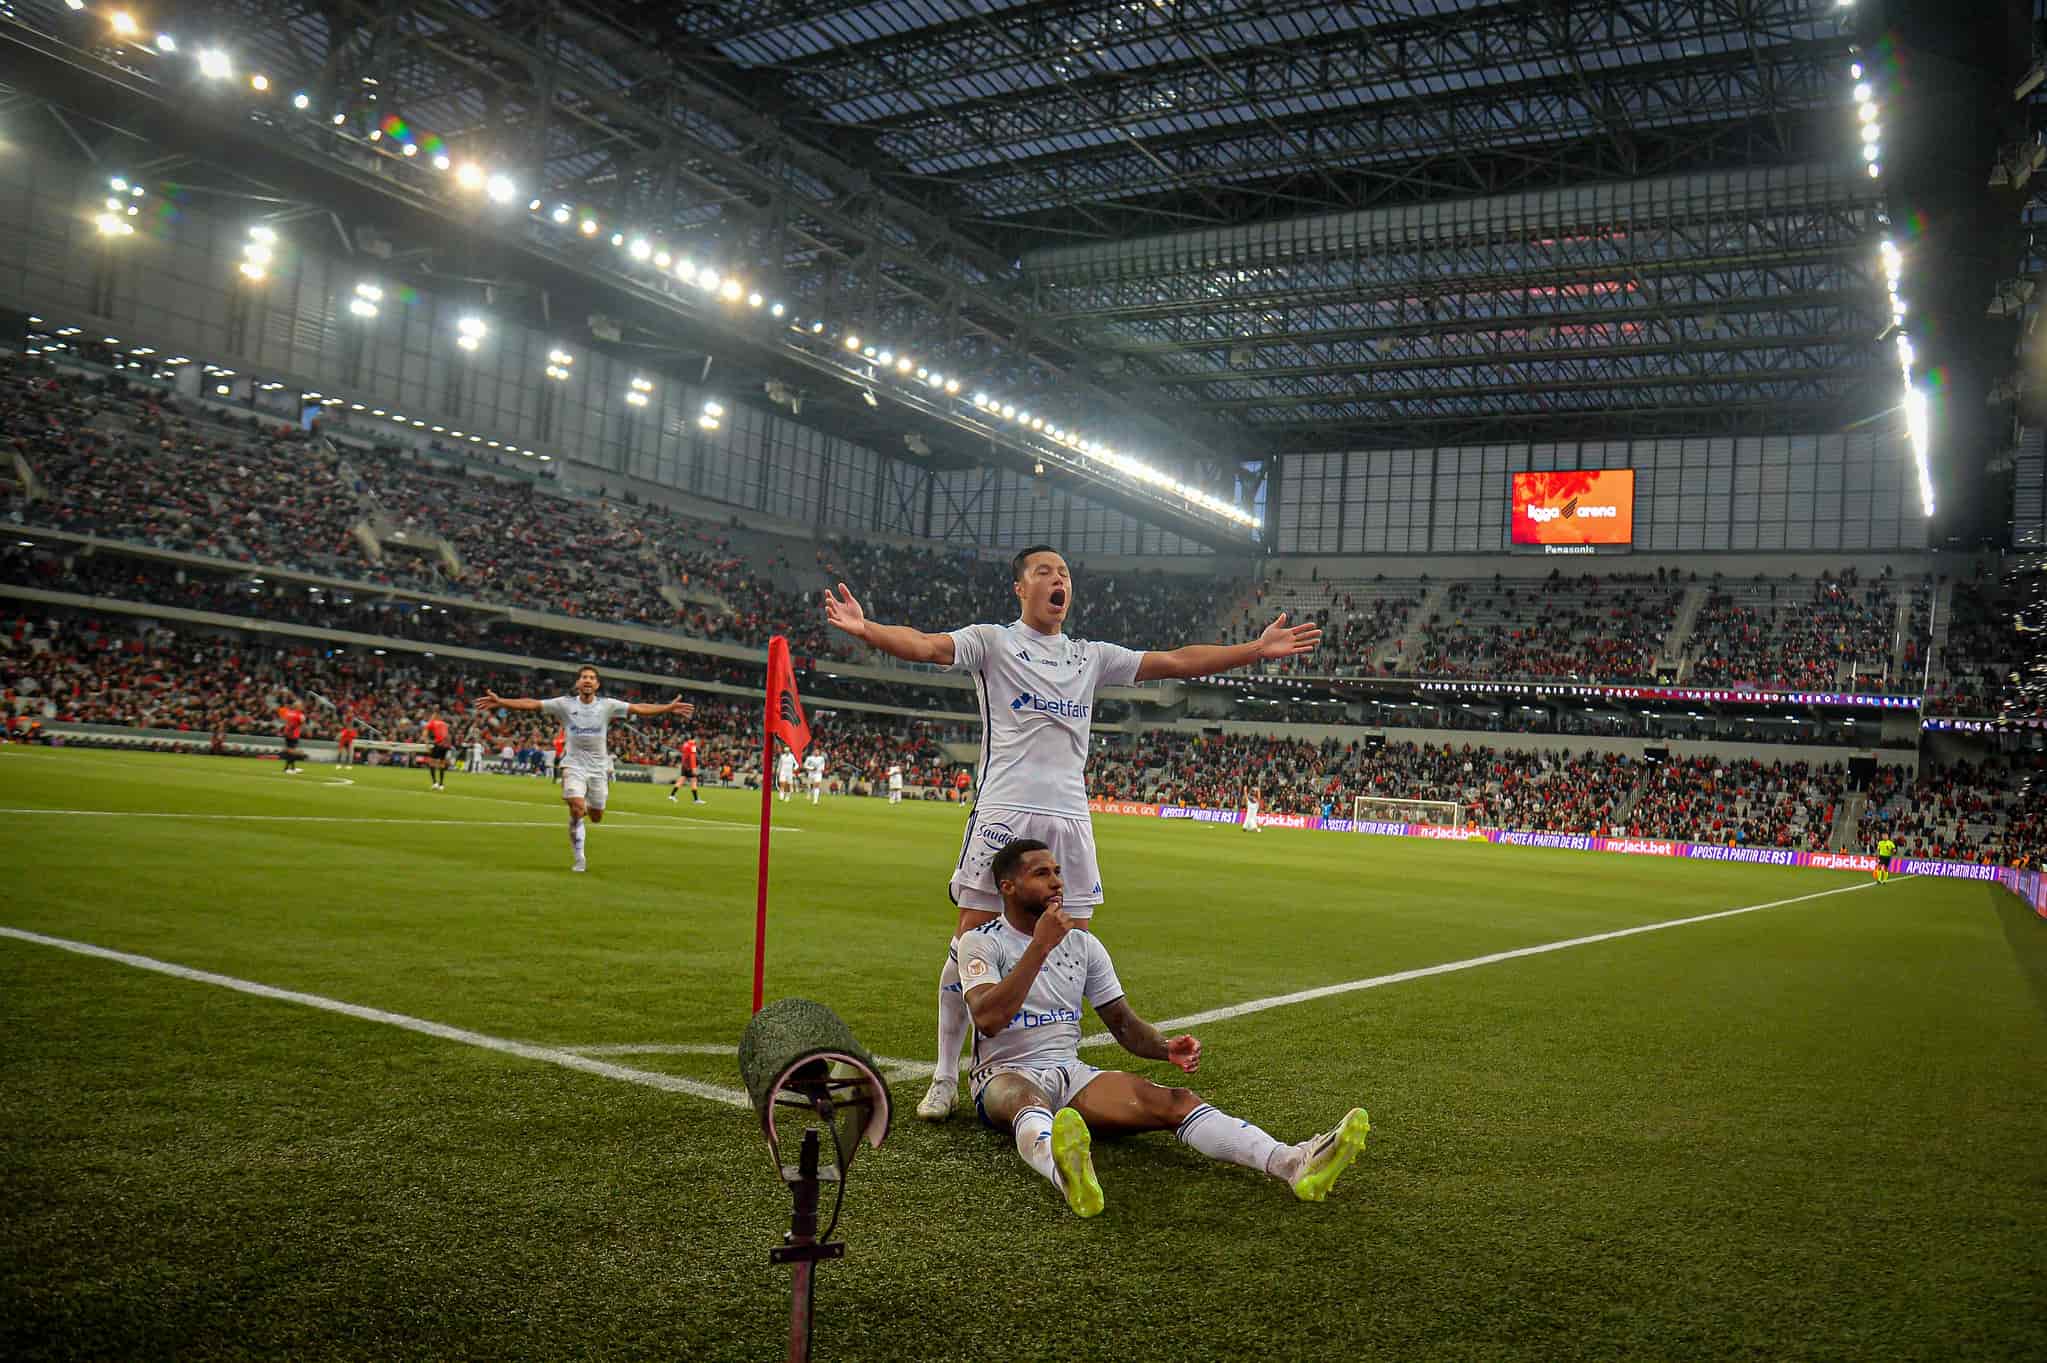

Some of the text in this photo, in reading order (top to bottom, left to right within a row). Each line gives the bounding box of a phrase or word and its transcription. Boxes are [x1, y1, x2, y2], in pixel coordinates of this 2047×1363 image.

[1577, 506, 1616, 518] arena
[1545, 544, 1595, 554] Panasonic
[1033, 694, 1089, 718] betfair
[1691, 846, 1722, 860] APOSTE
[1729, 848, 1758, 862] PARTIR
[1758, 849, 1771, 863] DE
[1906, 861, 1941, 876] APOSTE
